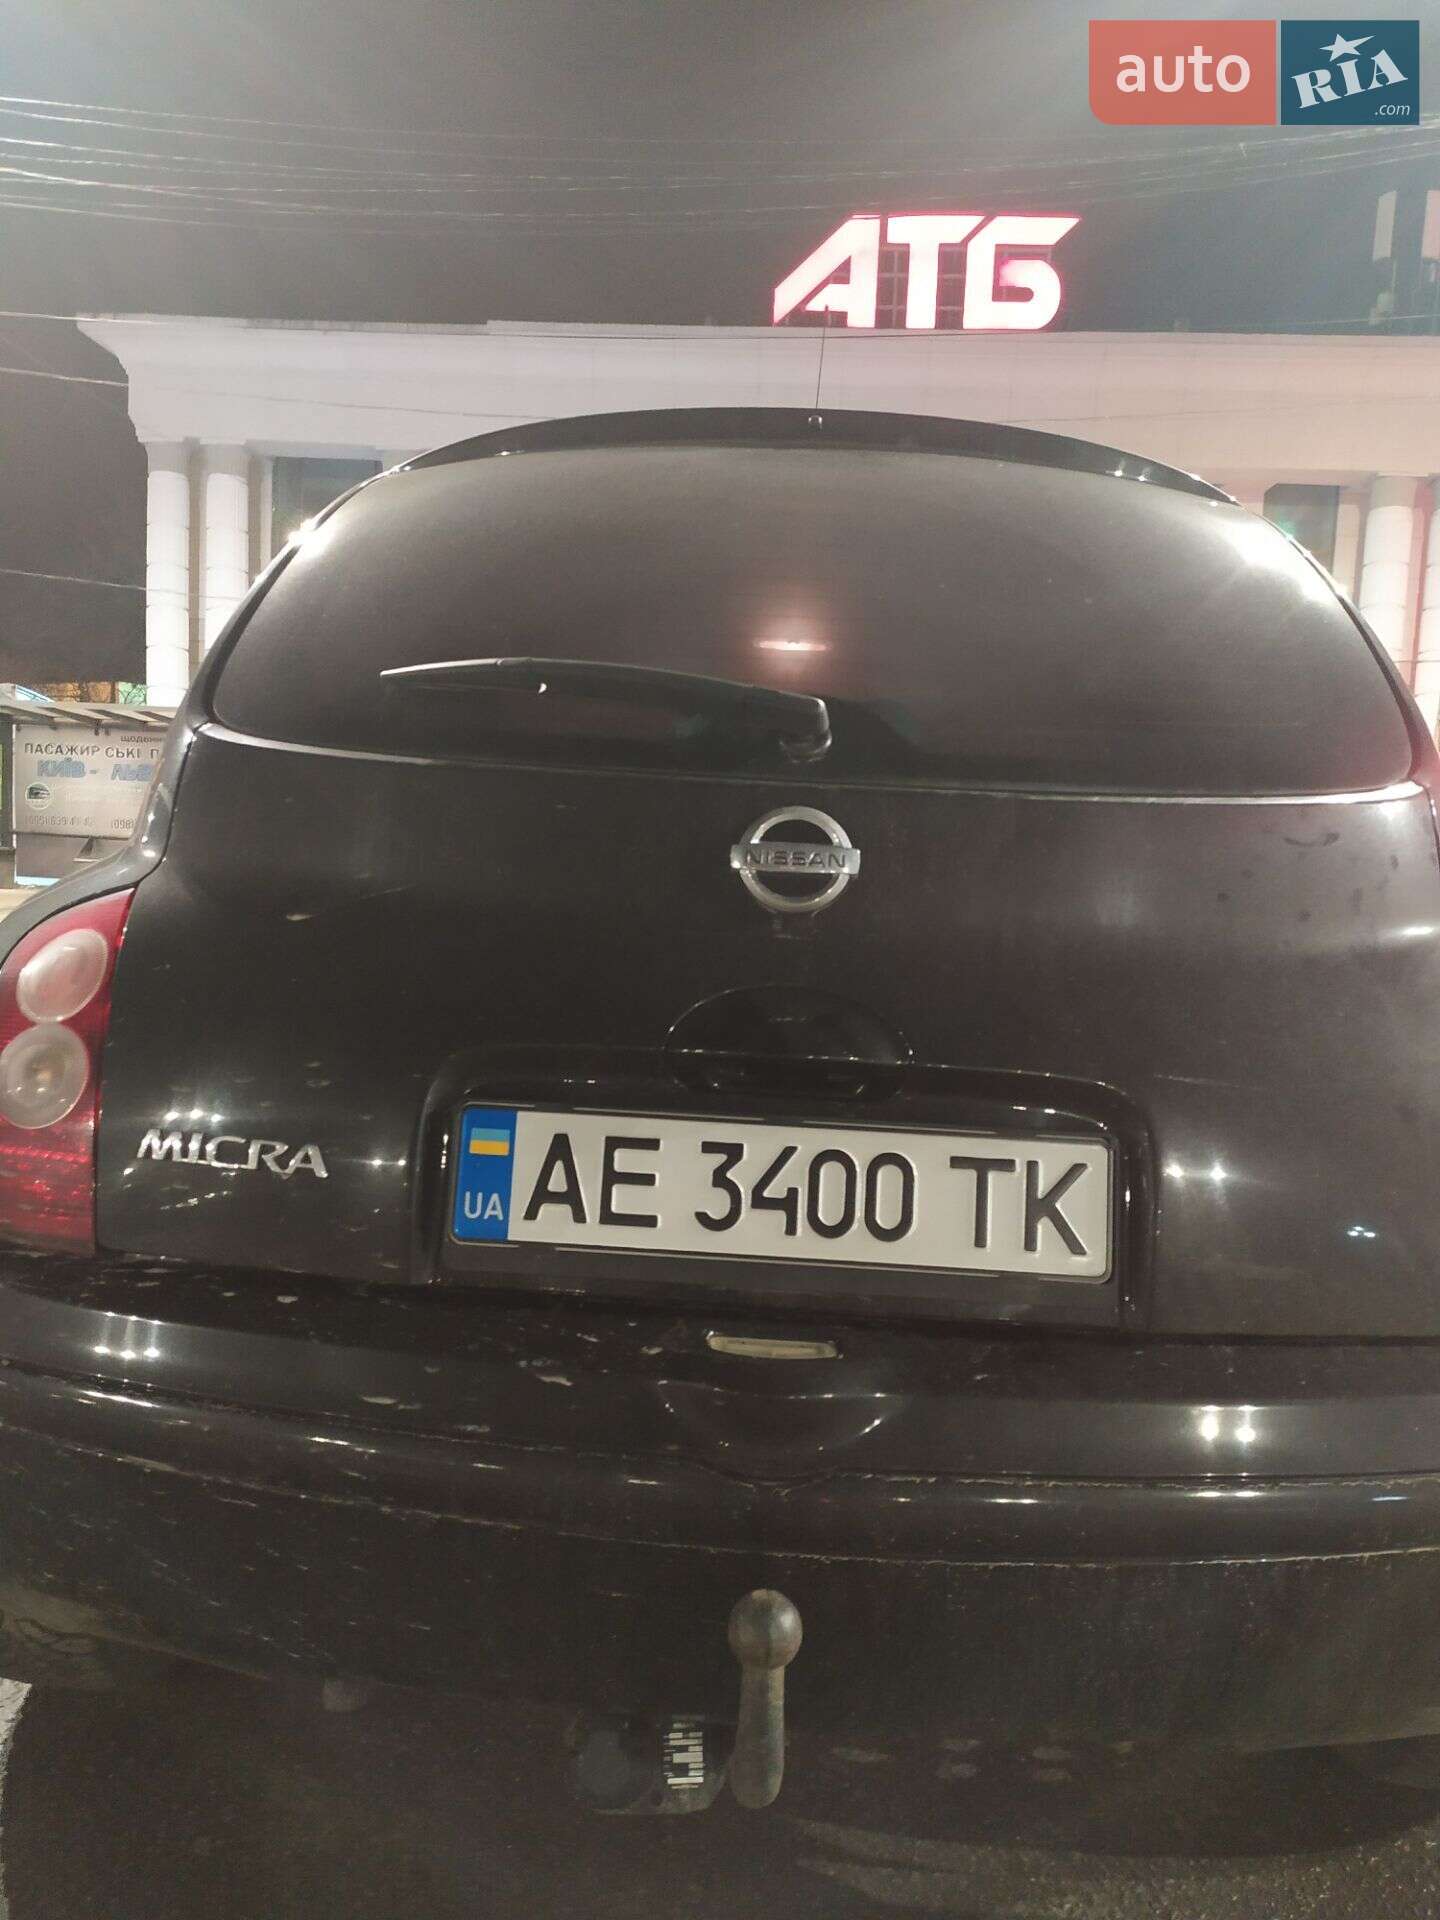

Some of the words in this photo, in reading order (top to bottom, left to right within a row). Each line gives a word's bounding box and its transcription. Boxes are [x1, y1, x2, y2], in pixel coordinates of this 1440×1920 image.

[773, 212, 1082, 330] АТБ
[746, 850, 846, 868] NISSAN
[136, 1128, 329, 1179] MICRA
[463, 1192, 504, 1221] UA
[522, 1132, 661, 1228] AE
[694, 1140, 916, 1243] 3400
[949, 1155, 1091, 1256] TK
